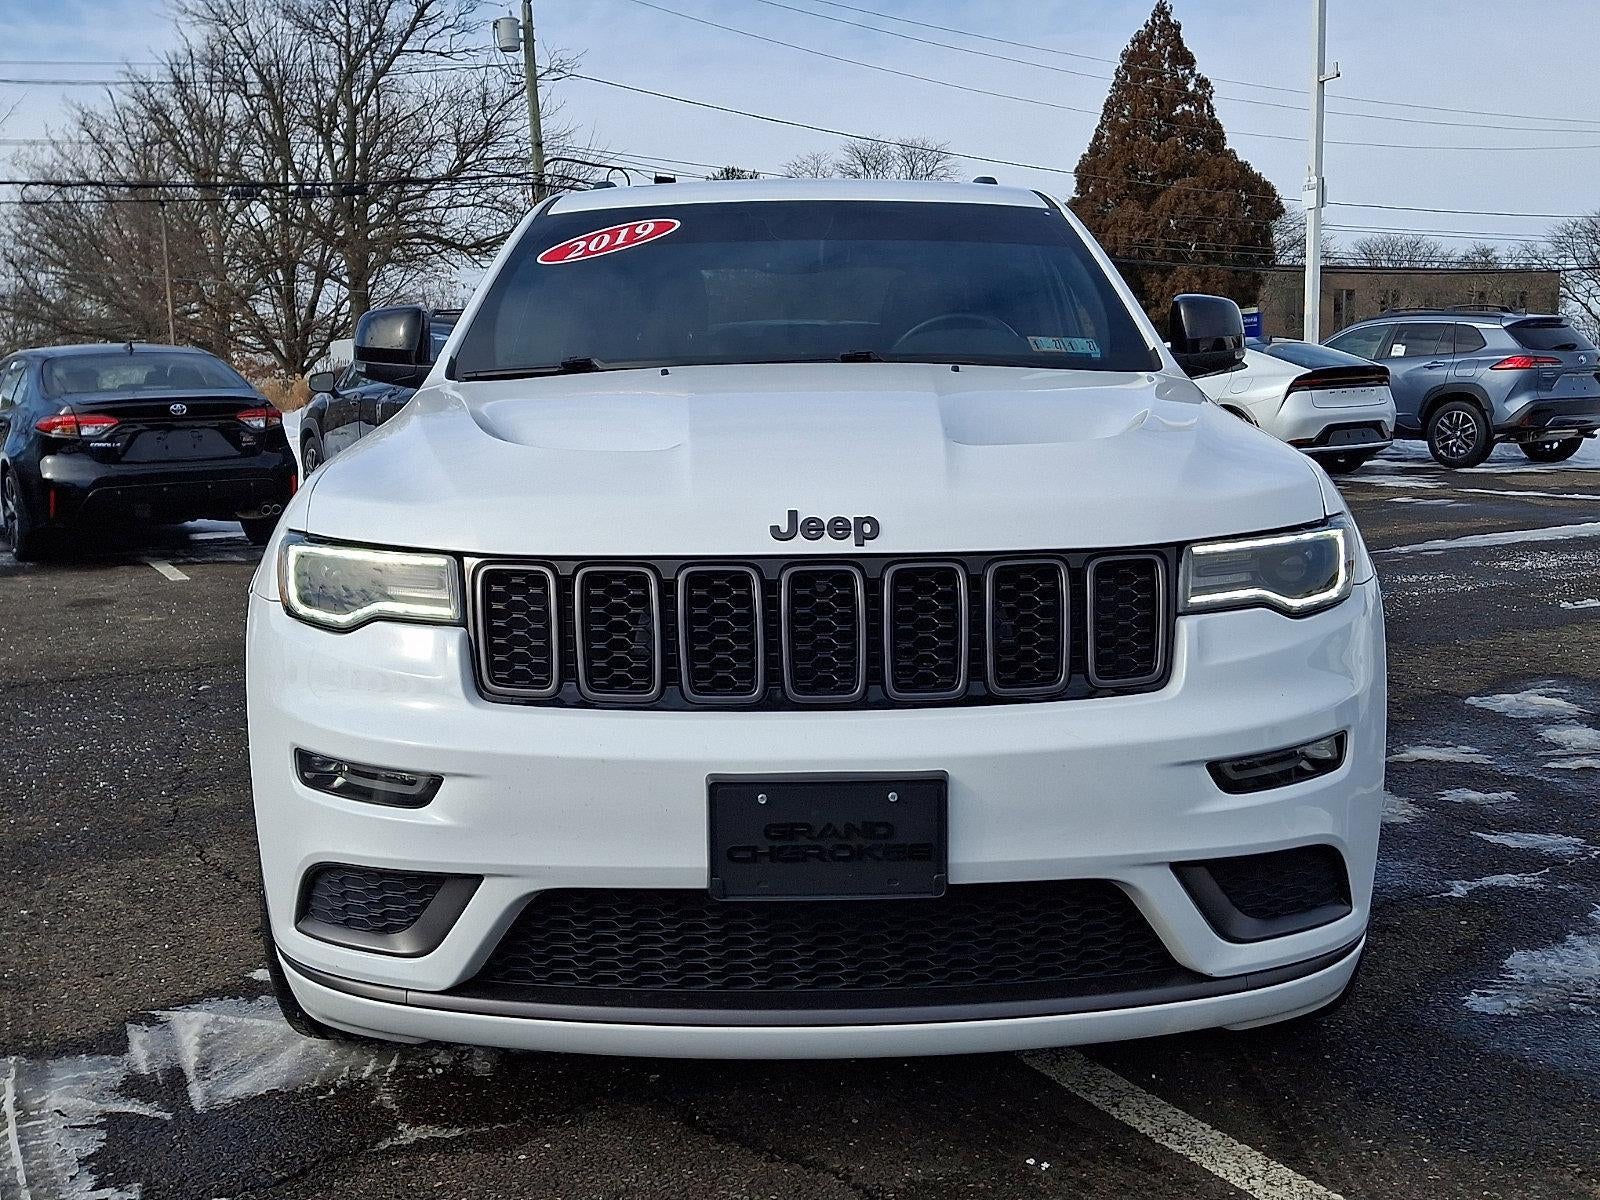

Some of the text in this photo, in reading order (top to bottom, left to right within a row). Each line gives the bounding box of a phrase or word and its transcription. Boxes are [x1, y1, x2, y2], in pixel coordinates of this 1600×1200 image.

[563, 221, 656, 260] 2019
[769, 509, 880, 547] Jeep
[763, 821, 895, 841] GRAND
[726, 842, 935, 864] CHEROKEE
